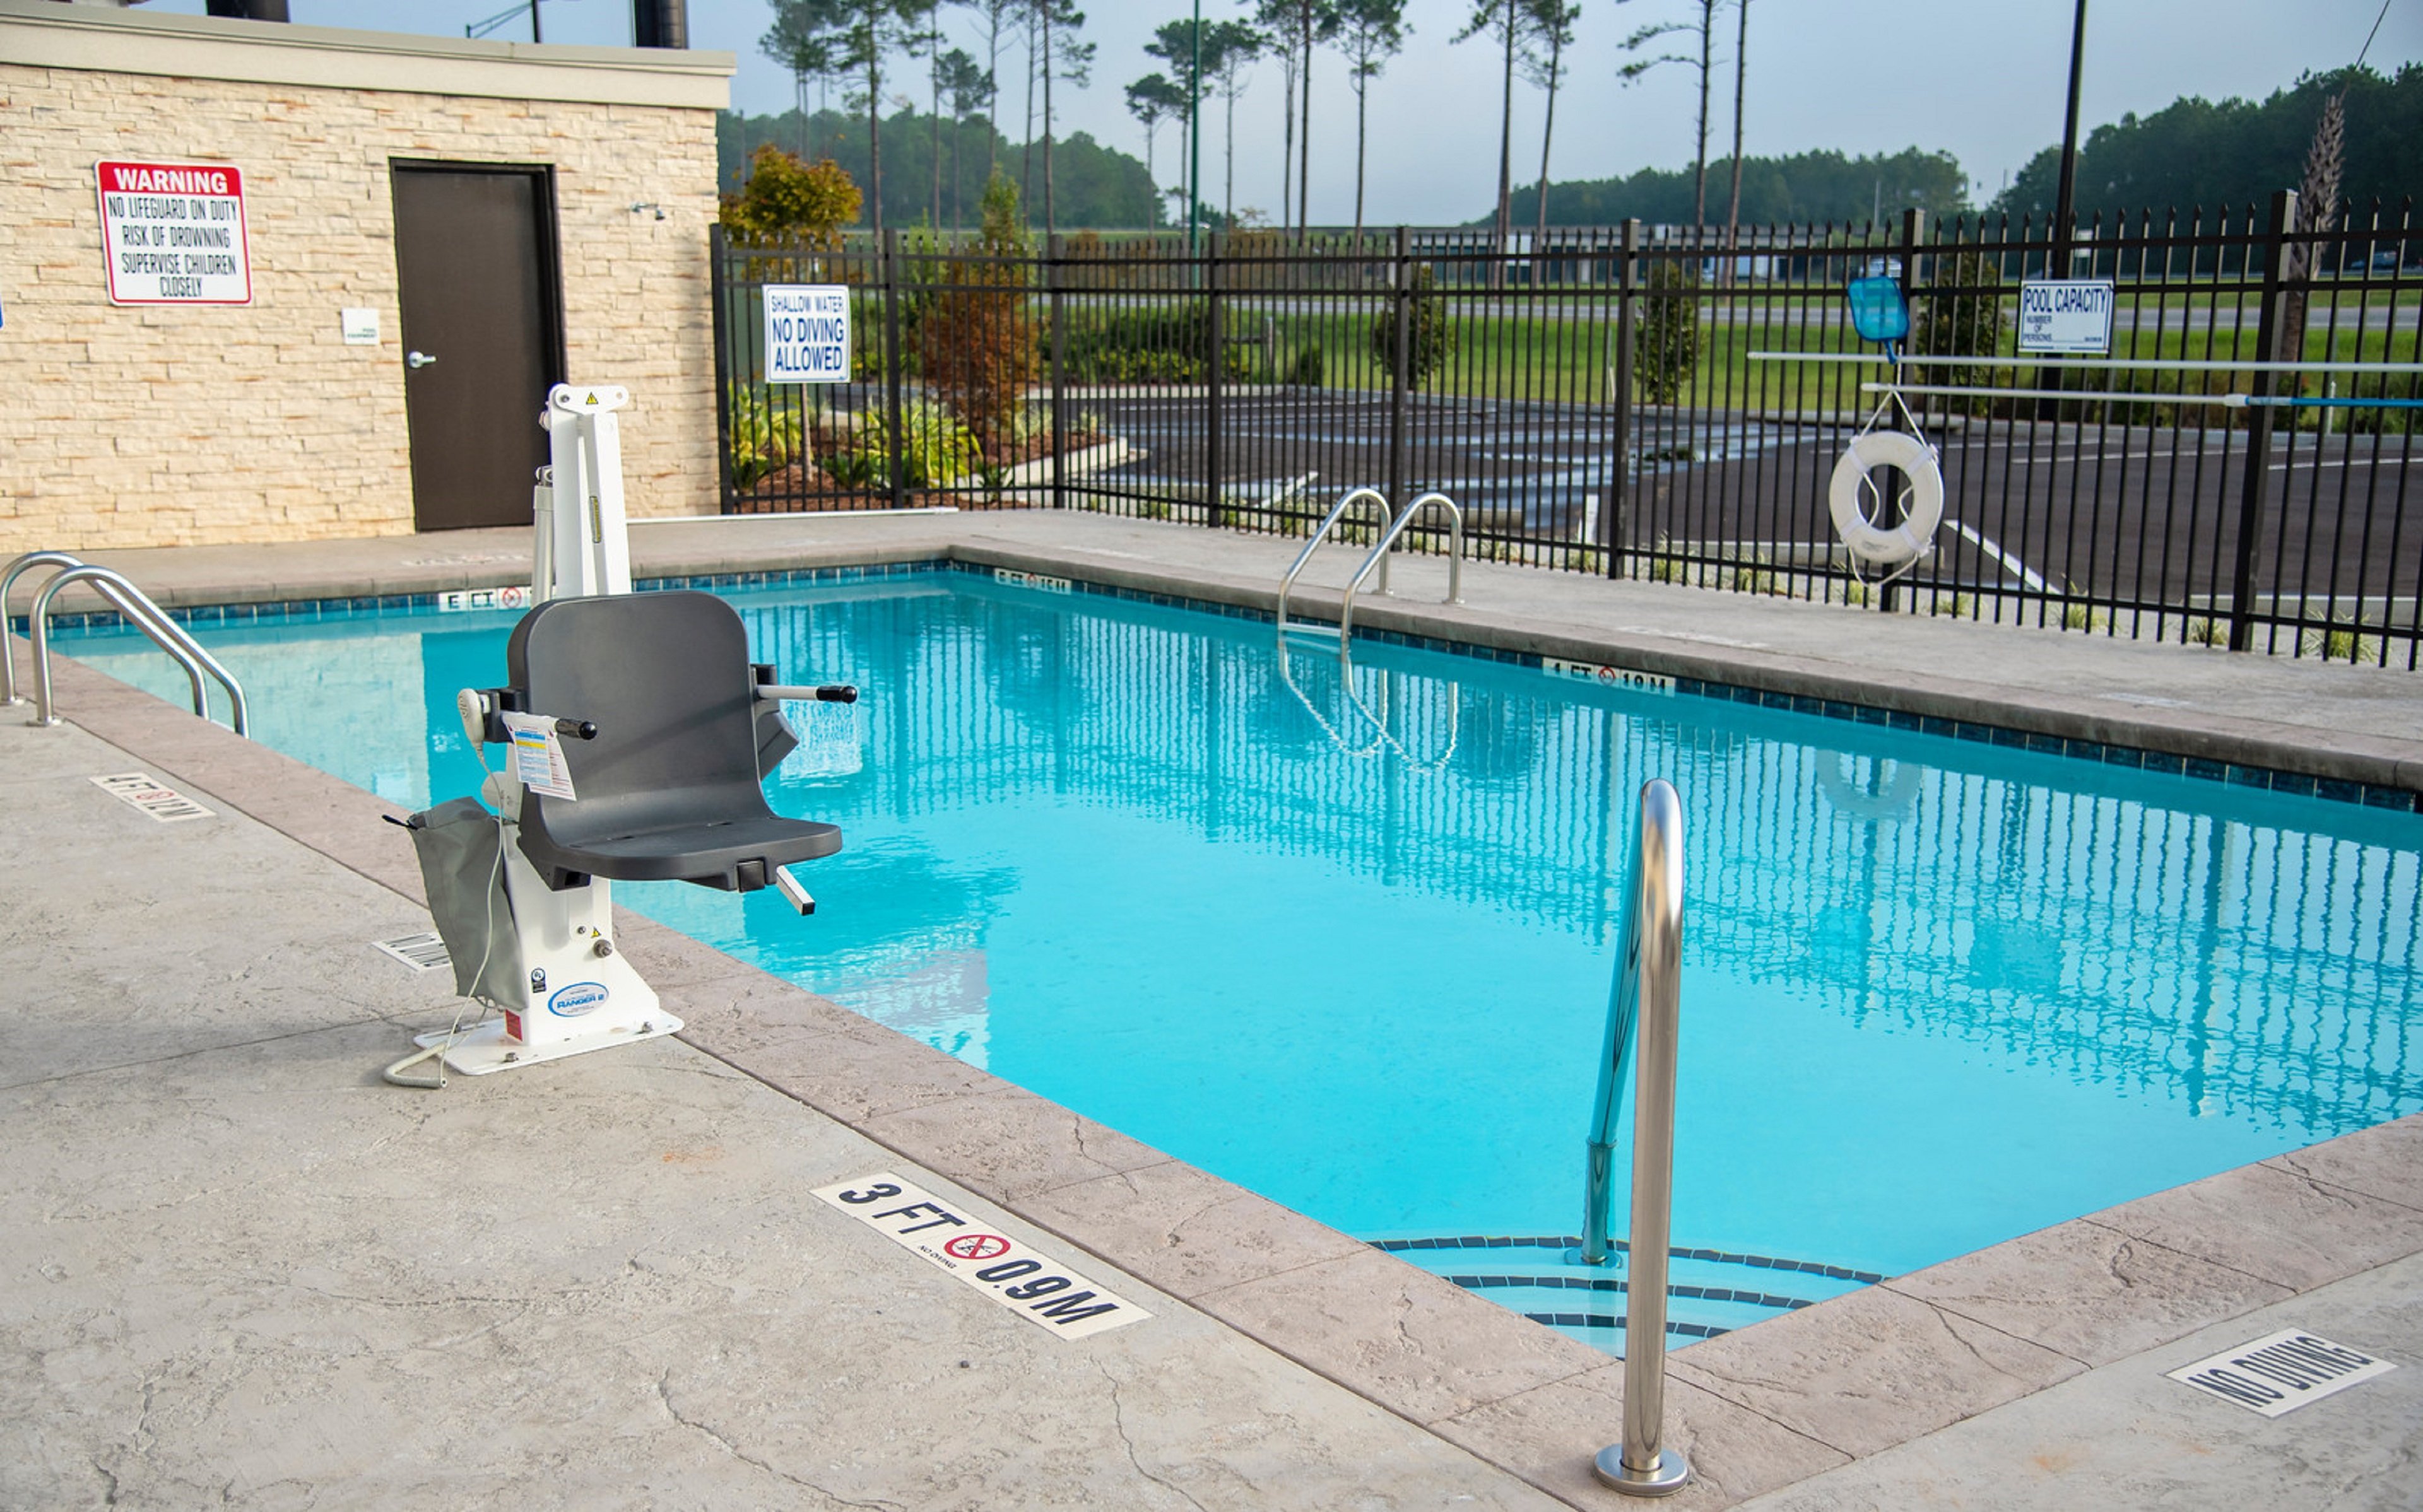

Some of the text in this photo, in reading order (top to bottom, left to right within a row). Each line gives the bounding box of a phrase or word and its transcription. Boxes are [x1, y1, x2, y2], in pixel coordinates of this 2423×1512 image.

[114, 168, 228, 194] WARNING
[108, 196, 237, 221] NO LIFEGUARD ON DUTY
[122, 225, 231, 248] RISK OF DROWNING
[122, 252, 237, 275] SUPERVISE CHILDREN
[160, 276, 203, 297] CLOSELY
[772, 295, 844, 312] SHALLOW WATER
[2024, 288, 2106, 314] POOL CAPACITY
[772, 318, 844, 343] NO DIVING
[2026, 315, 2052, 324] NUMBER
[2034, 324, 2042, 334] OF
[2024, 334, 2052, 342] PERSONS
[775, 346, 842, 371] ALLOWED
[839, 1183, 1120, 1325] 3 FT 0.9M
[930, 1251, 958, 1269] DIVING
[2187, 1335, 2375, 1408] NO DIVING
